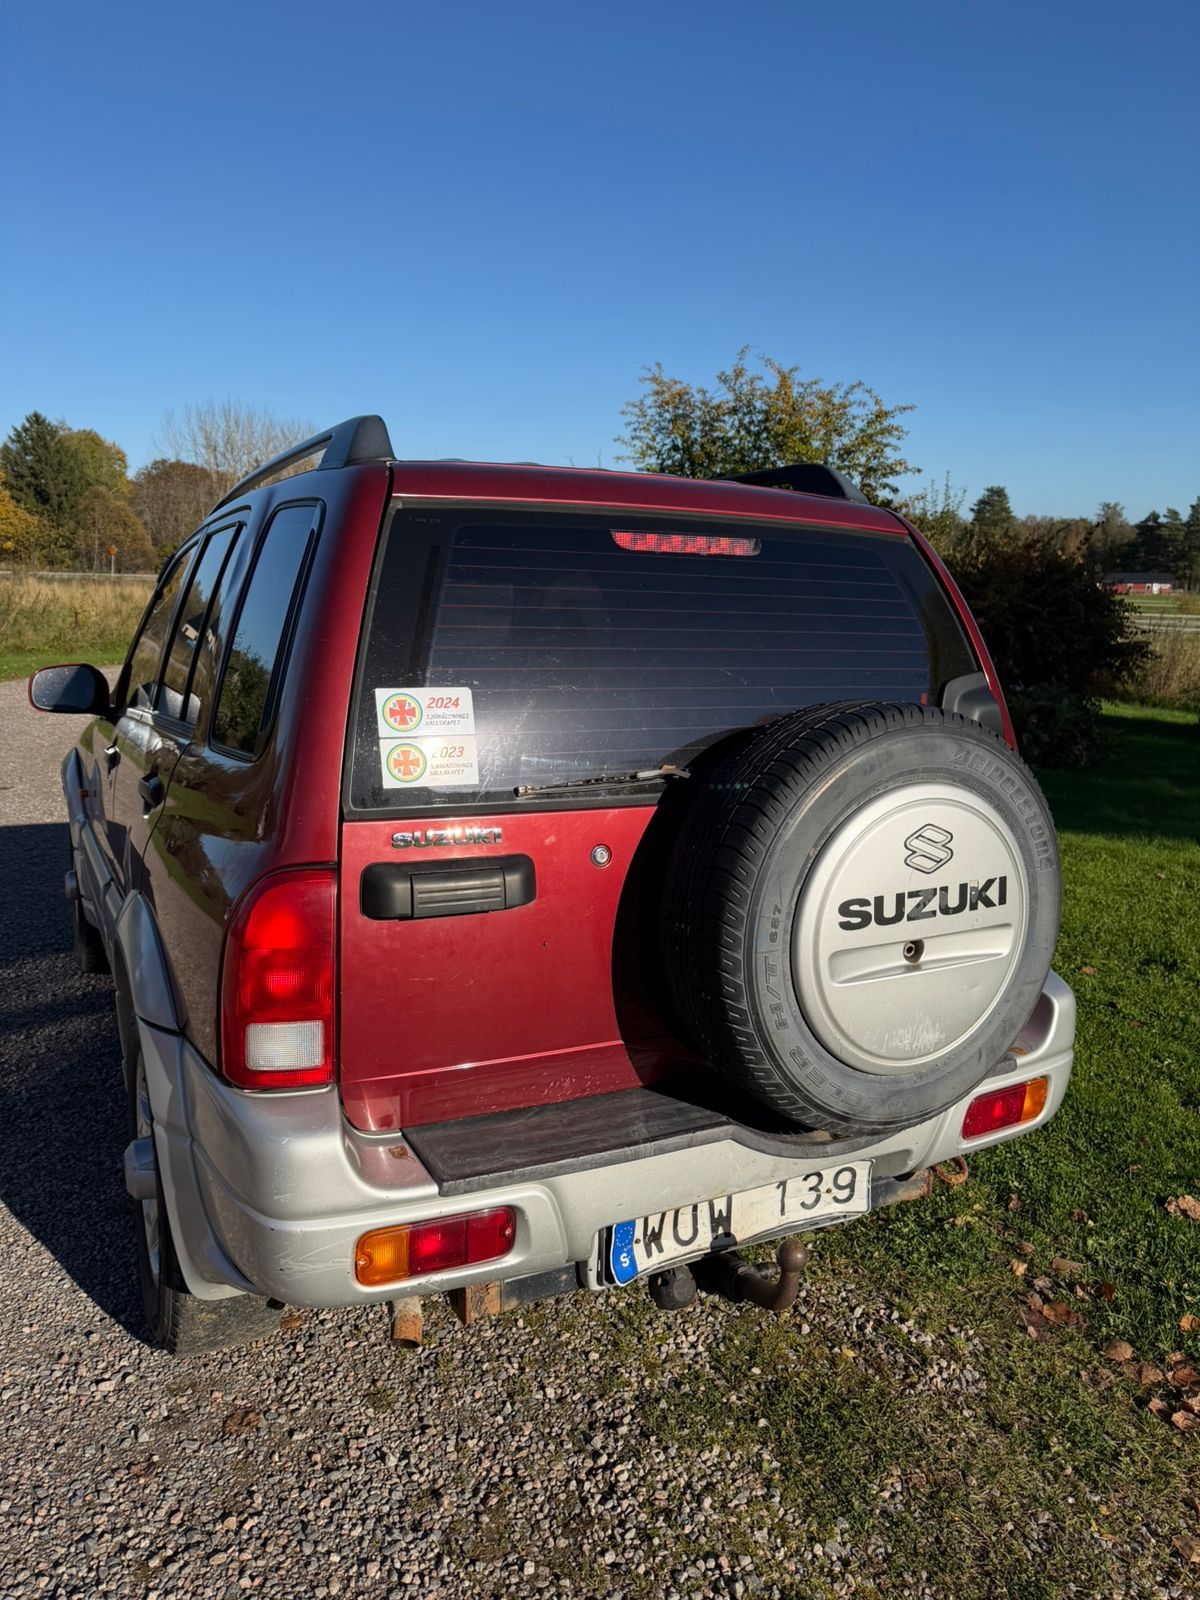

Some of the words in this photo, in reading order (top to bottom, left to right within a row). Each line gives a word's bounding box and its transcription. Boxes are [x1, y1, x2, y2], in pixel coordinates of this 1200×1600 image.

[426, 696, 460, 709] 2024
[431, 746, 465, 758] 2023
[950, 746, 1056, 871] BRIDGESTONE
[391, 827, 502, 849] SUZUKI
[768, 904, 782, 944] 687
[837, 876, 1008, 931] SUZUKI
[763, 955, 790, 1031] H/T
[787, 1044, 913, 1112] DUELER
[775, 1166, 857, 1216] 139
[620, 1252, 630, 1268] S
